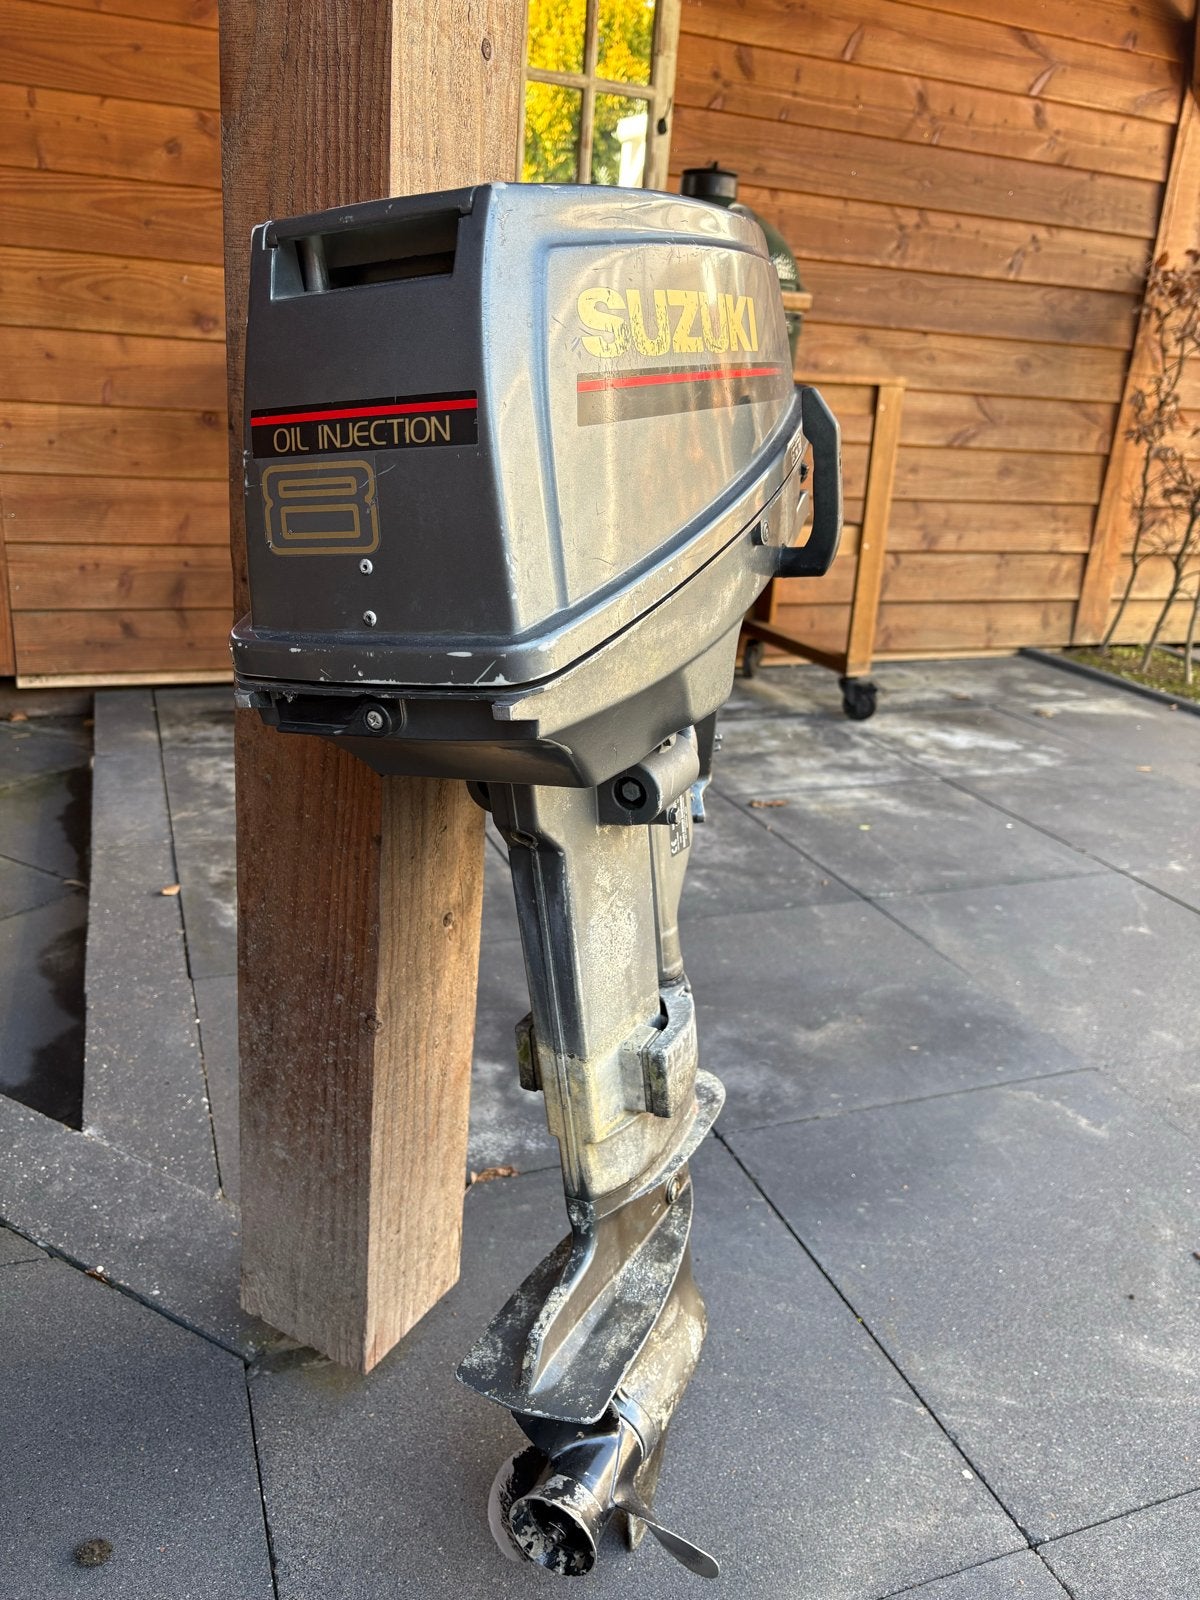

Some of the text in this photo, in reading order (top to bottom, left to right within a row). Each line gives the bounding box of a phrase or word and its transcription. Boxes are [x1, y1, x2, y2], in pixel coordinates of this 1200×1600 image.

[578, 287, 758, 358] SUZUKI
[273, 415, 451, 453] OIL INJECTION
[262, 460, 380, 556] 8
